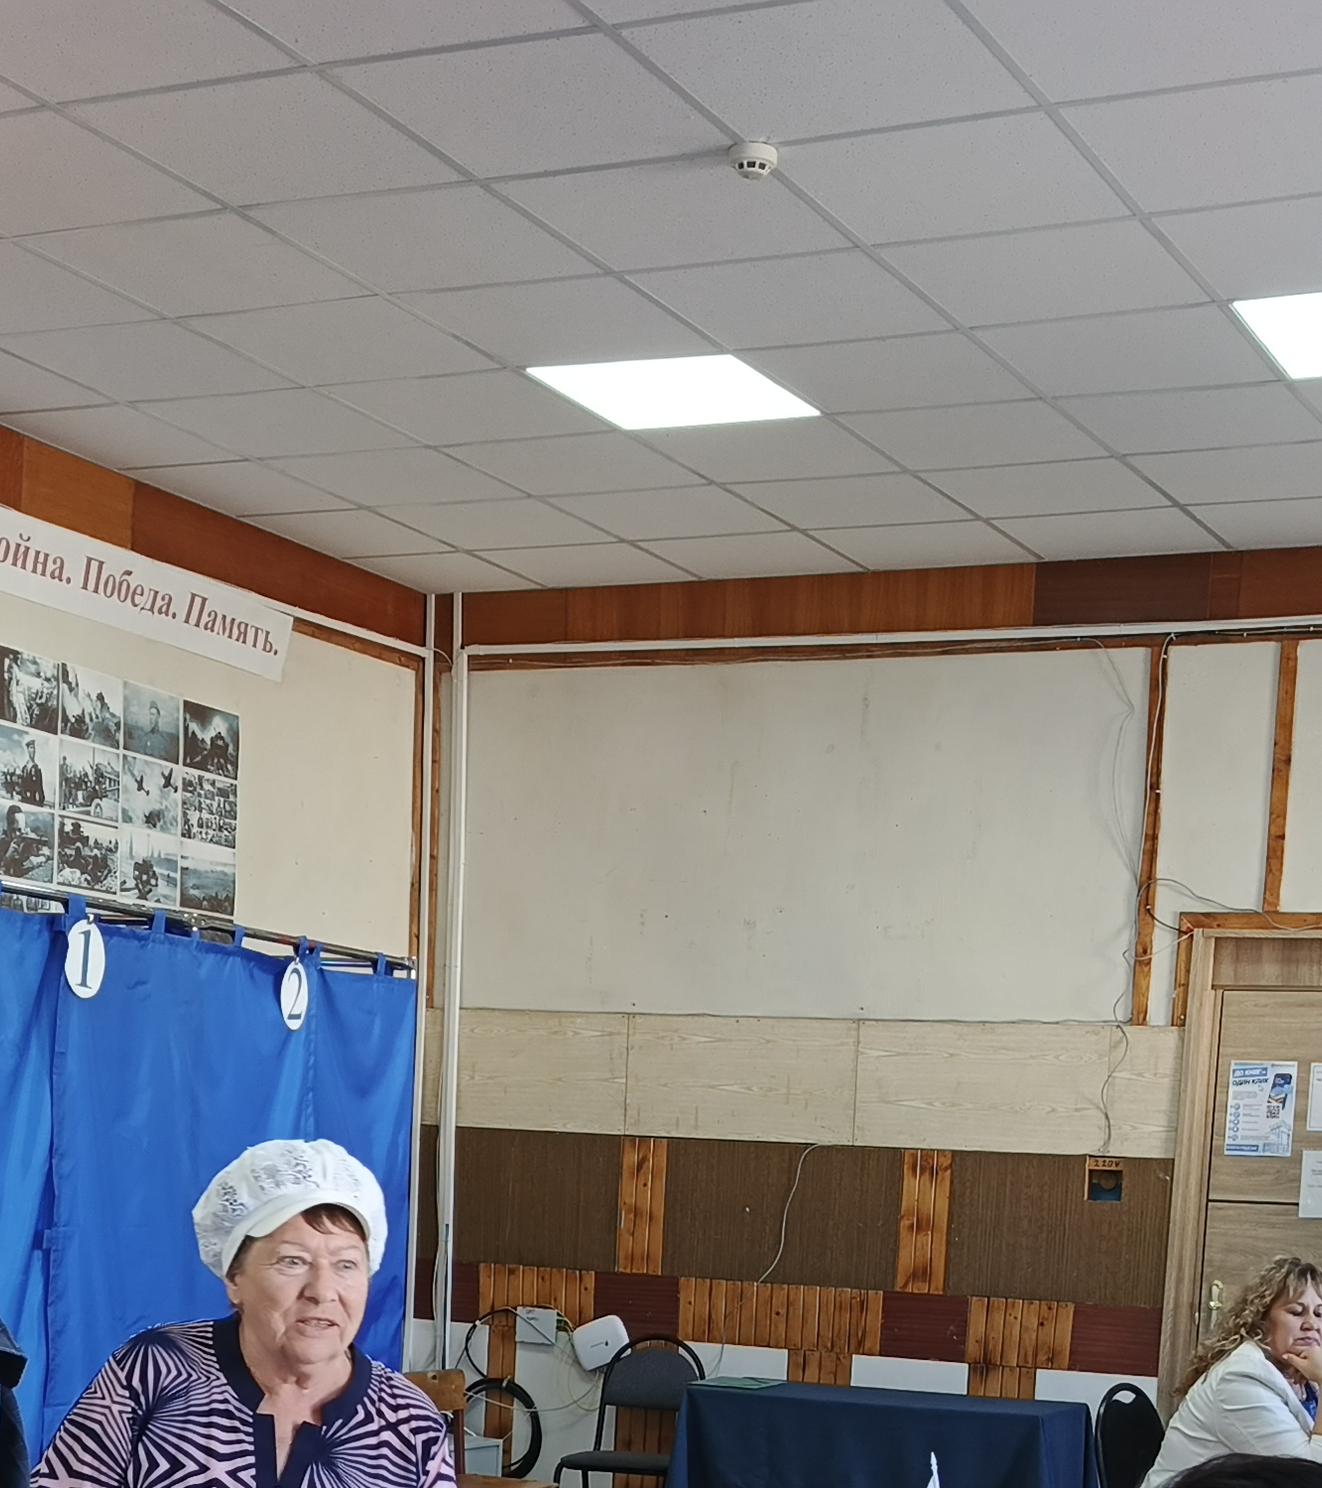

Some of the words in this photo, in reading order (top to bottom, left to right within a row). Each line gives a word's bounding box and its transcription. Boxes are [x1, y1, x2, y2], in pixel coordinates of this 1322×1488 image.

[81, 556, 177, 620] Победа.
[181, 592, 279, 657] Память.
[75, 929, 91, 989] 1
[287, 967, 303, 1021] 2
